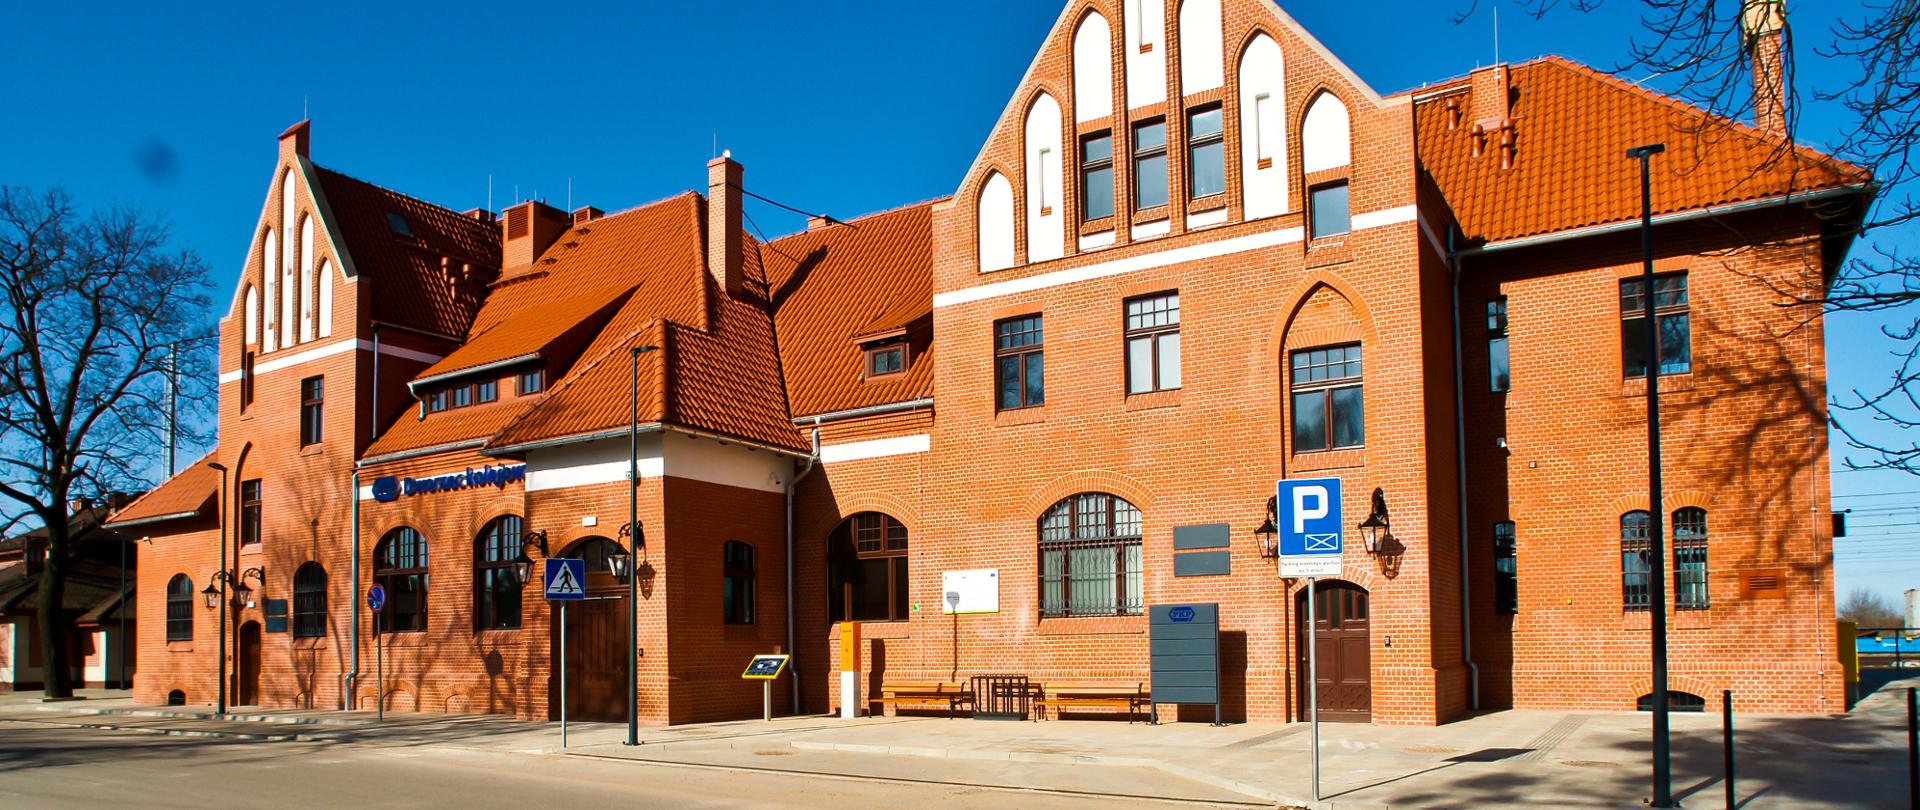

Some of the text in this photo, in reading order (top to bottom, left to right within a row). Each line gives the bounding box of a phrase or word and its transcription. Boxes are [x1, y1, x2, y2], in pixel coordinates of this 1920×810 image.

[404, 474, 466, 497] Dworzec
[1292, 485, 1329, 534] P
[1171, 610, 1192, 618] PKP
